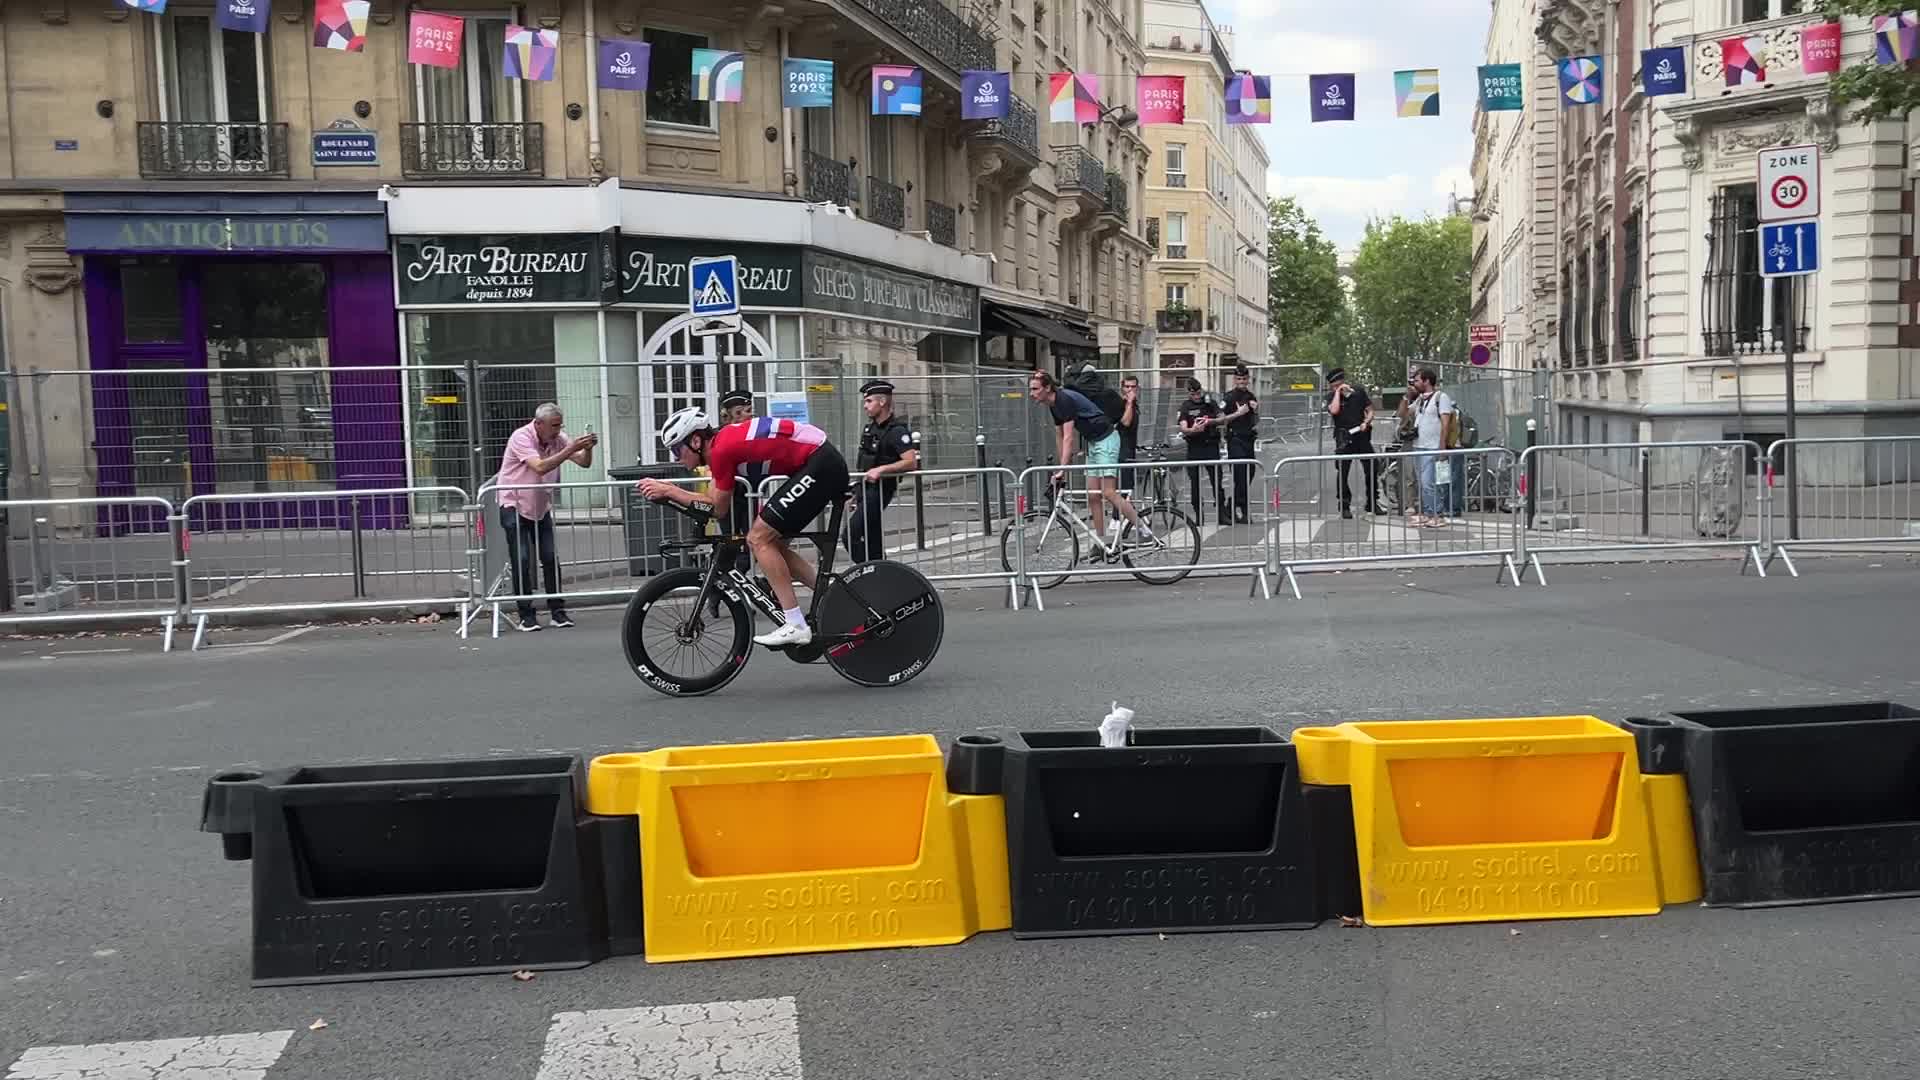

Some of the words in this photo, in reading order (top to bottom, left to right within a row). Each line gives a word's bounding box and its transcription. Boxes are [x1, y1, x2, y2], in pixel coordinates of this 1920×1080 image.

[229, 5, 255, 15] PARIS
[415, 26, 454, 40] PARIS
[415, 39, 453, 52] 2024
[1807, 38, 1836, 49] PARIS
[1808, 49, 1837, 60] 2024
[610, 65, 636, 75] PARIS
[1654, 71, 1677, 81] PARIS
[789, 72, 826, 82] PARIS
[1484, 77, 1518, 87] PARIS
[789, 83, 826, 93] 2024
[1144, 89, 1179, 99] PARIS
[1486, 87, 1520, 98] 2024
[974, 94, 999, 104] PARIS
[1145, 100, 1179, 110] 2024
[1322, 97, 1346, 106] PARIS
[1769, 155, 1808, 168] ZONE
[1779, 185, 1800, 199] 30
[118, 218, 329, 250] ANTIQUITÉS
[408, 245, 476, 281] ART
[480, 246, 588, 274] BUREAU
[622, 251, 686, 294] ART
[737, 266, 793, 292] REAU
[466, 276, 534, 286] FAYOLLE
[466, 288, 504, 302] depuis
[506, 287, 534, 299] 1894
[863, 275, 912, 310] BUREAUX
[779, 474, 816, 508] NOR
[728, 569, 786, 624] DARE
[888, 672, 901, 682] DT
[901, 659, 923, 678] SWISS
[638, 664, 654, 677] DT
[651, 676, 681, 692] SWISS
[1472, 850, 1561, 879] sodirel
[1585, 851, 1640, 875] com
[763, 876, 861, 910] sodirel
[886, 875, 946, 903] com
[1417, 887, 1448, 913] 04
[1456, 885, 1486, 911] 90
[1493, 883, 1520, 909] 11
[1534, 882, 1561, 908] 16
[1570, 880, 1599, 906] 00
[703, 919, 736, 948] 04
[745, 916, 776, 944] 90
[784, 914, 818, 943] 11
[831, 911, 858, 940] 16
[870, 908, 901, 937] 00
